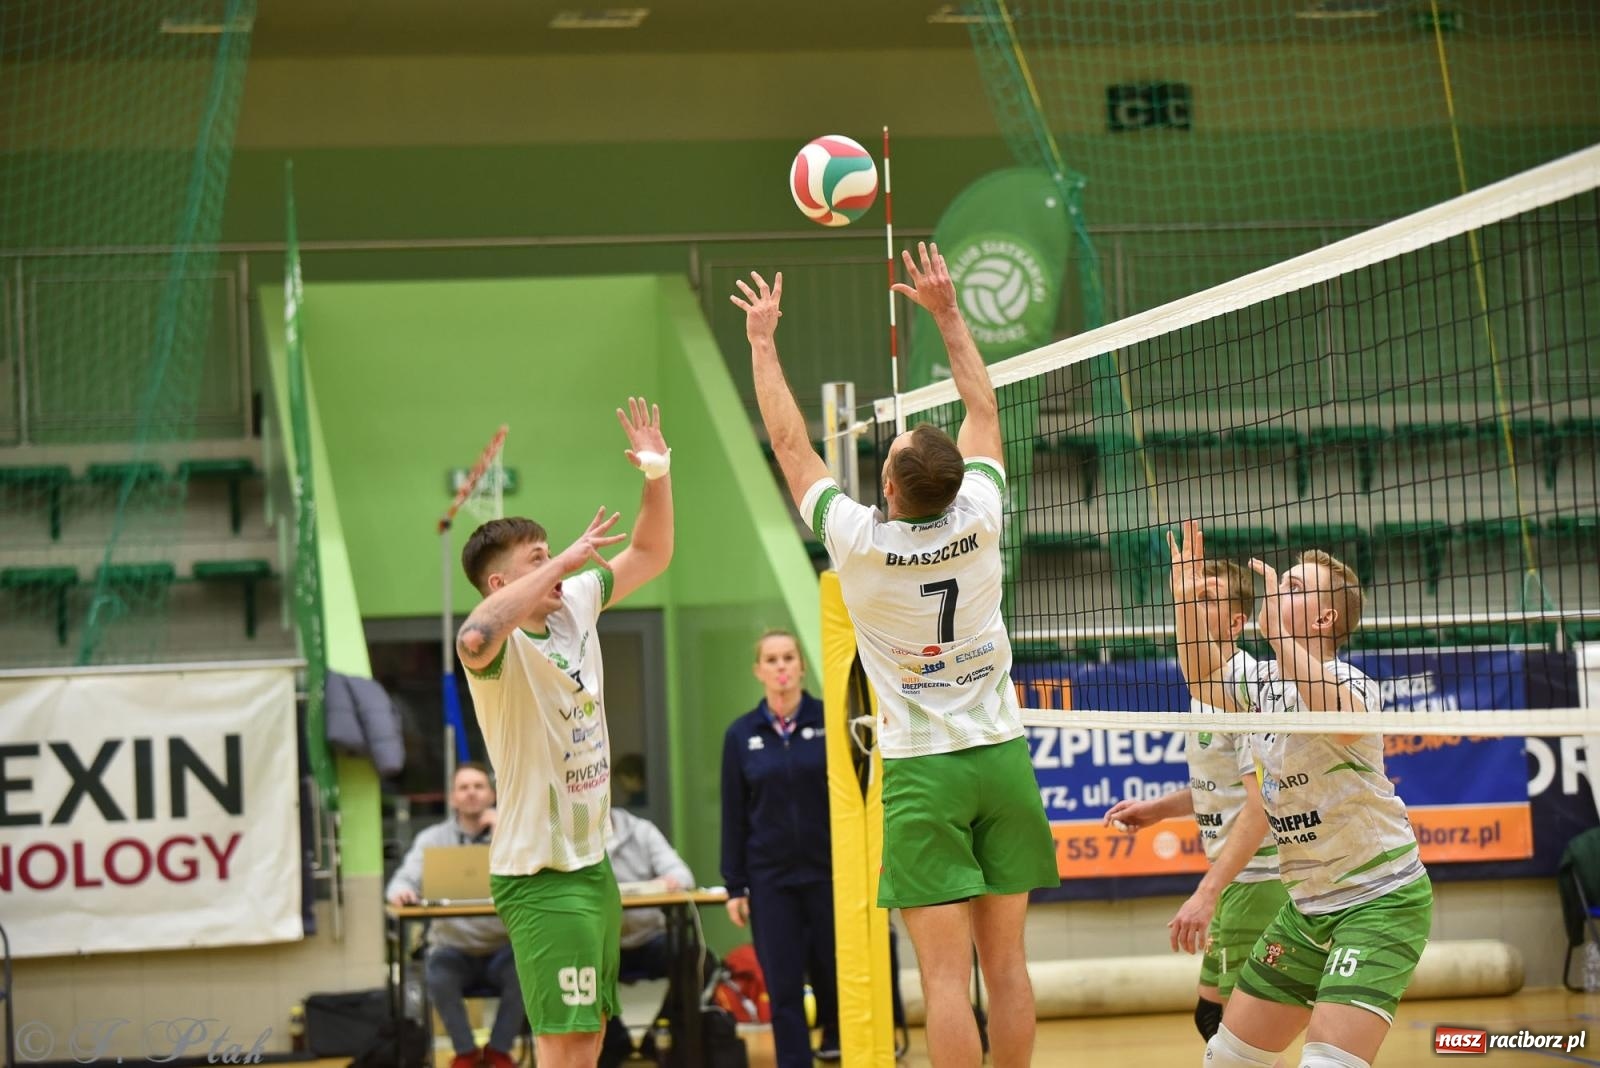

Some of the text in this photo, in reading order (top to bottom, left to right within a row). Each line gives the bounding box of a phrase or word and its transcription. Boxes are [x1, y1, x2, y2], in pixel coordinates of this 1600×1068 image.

[885, 532, 979, 567] BŁASZCZOK
[919, 577, 959, 643] 7
[1082, 778, 1119, 808] ul.
[1416, 820, 1502, 849] borz.pl
[1329, 947, 1361, 978] 15
[557, 965, 597, 1006] 99
